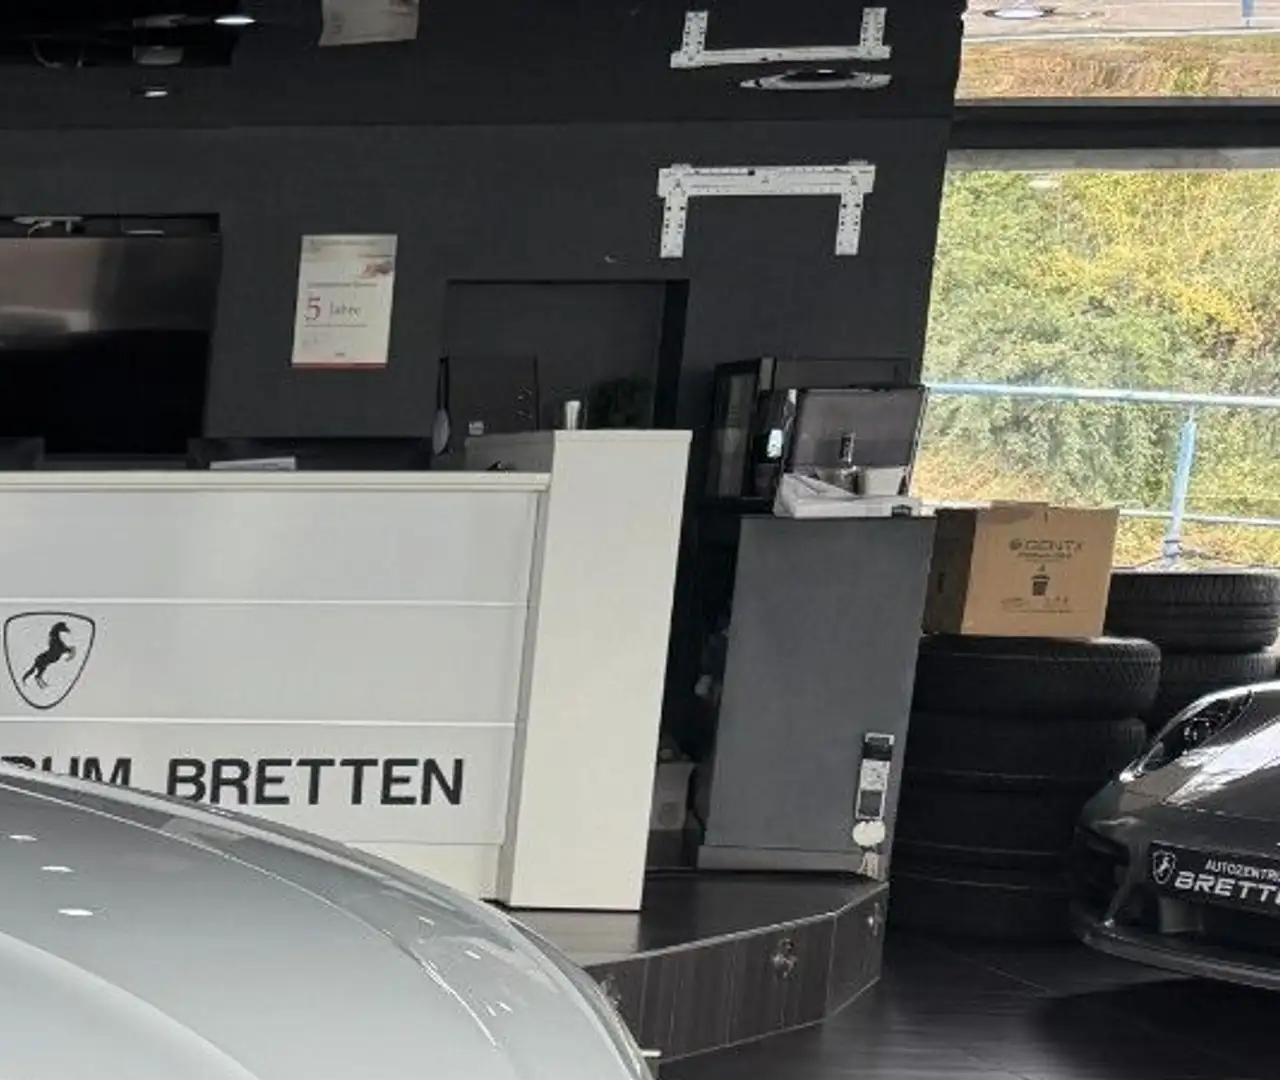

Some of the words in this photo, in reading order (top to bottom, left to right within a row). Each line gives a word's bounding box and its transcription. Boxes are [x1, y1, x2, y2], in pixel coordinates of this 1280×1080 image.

[303, 296, 321, 320] 5
[166, 758, 464, 805] BRETTEN
[1204, 859, 1280, 882] AUTOZENTR
